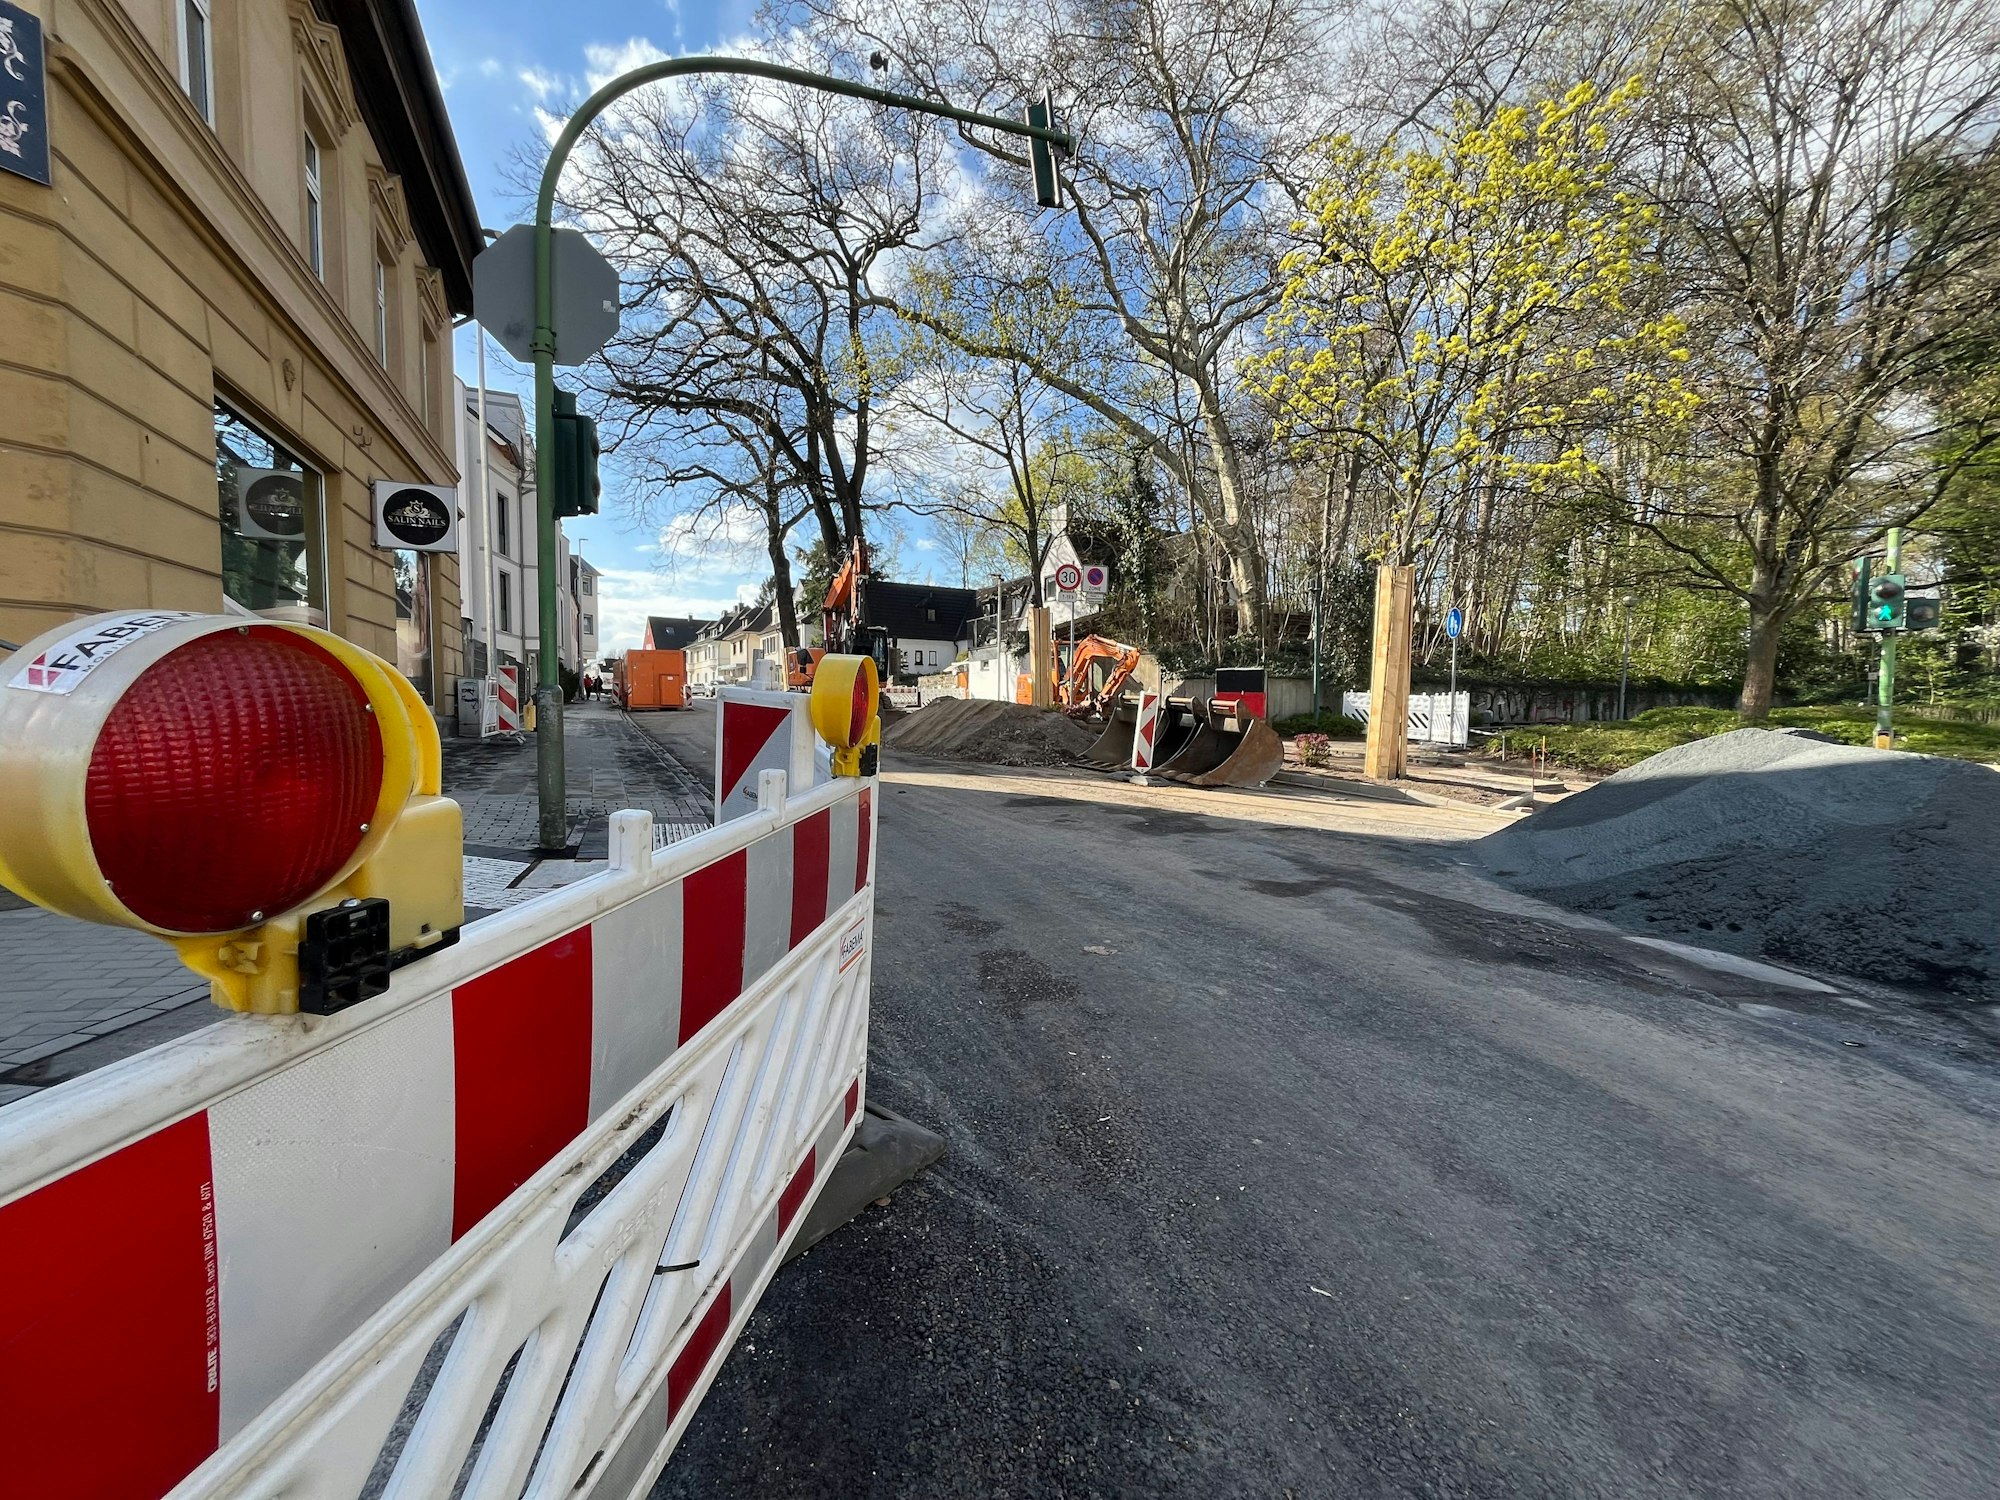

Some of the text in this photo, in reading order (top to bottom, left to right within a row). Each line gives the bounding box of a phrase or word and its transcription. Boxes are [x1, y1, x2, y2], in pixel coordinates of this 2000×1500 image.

[387, 515, 446, 527] SALIN NAILS
[1061, 571, 1076, 584] 30
[200, 1181, 211, 1200] 6171
[202, 1202, 212, 1211] &
[202, 1213, 214, 1240] 67520
[204, 1241, 215, 1261] DIN
[206, 1260, 215, 1283] nach
[207, 1347, 217, 1393] ORALITE
